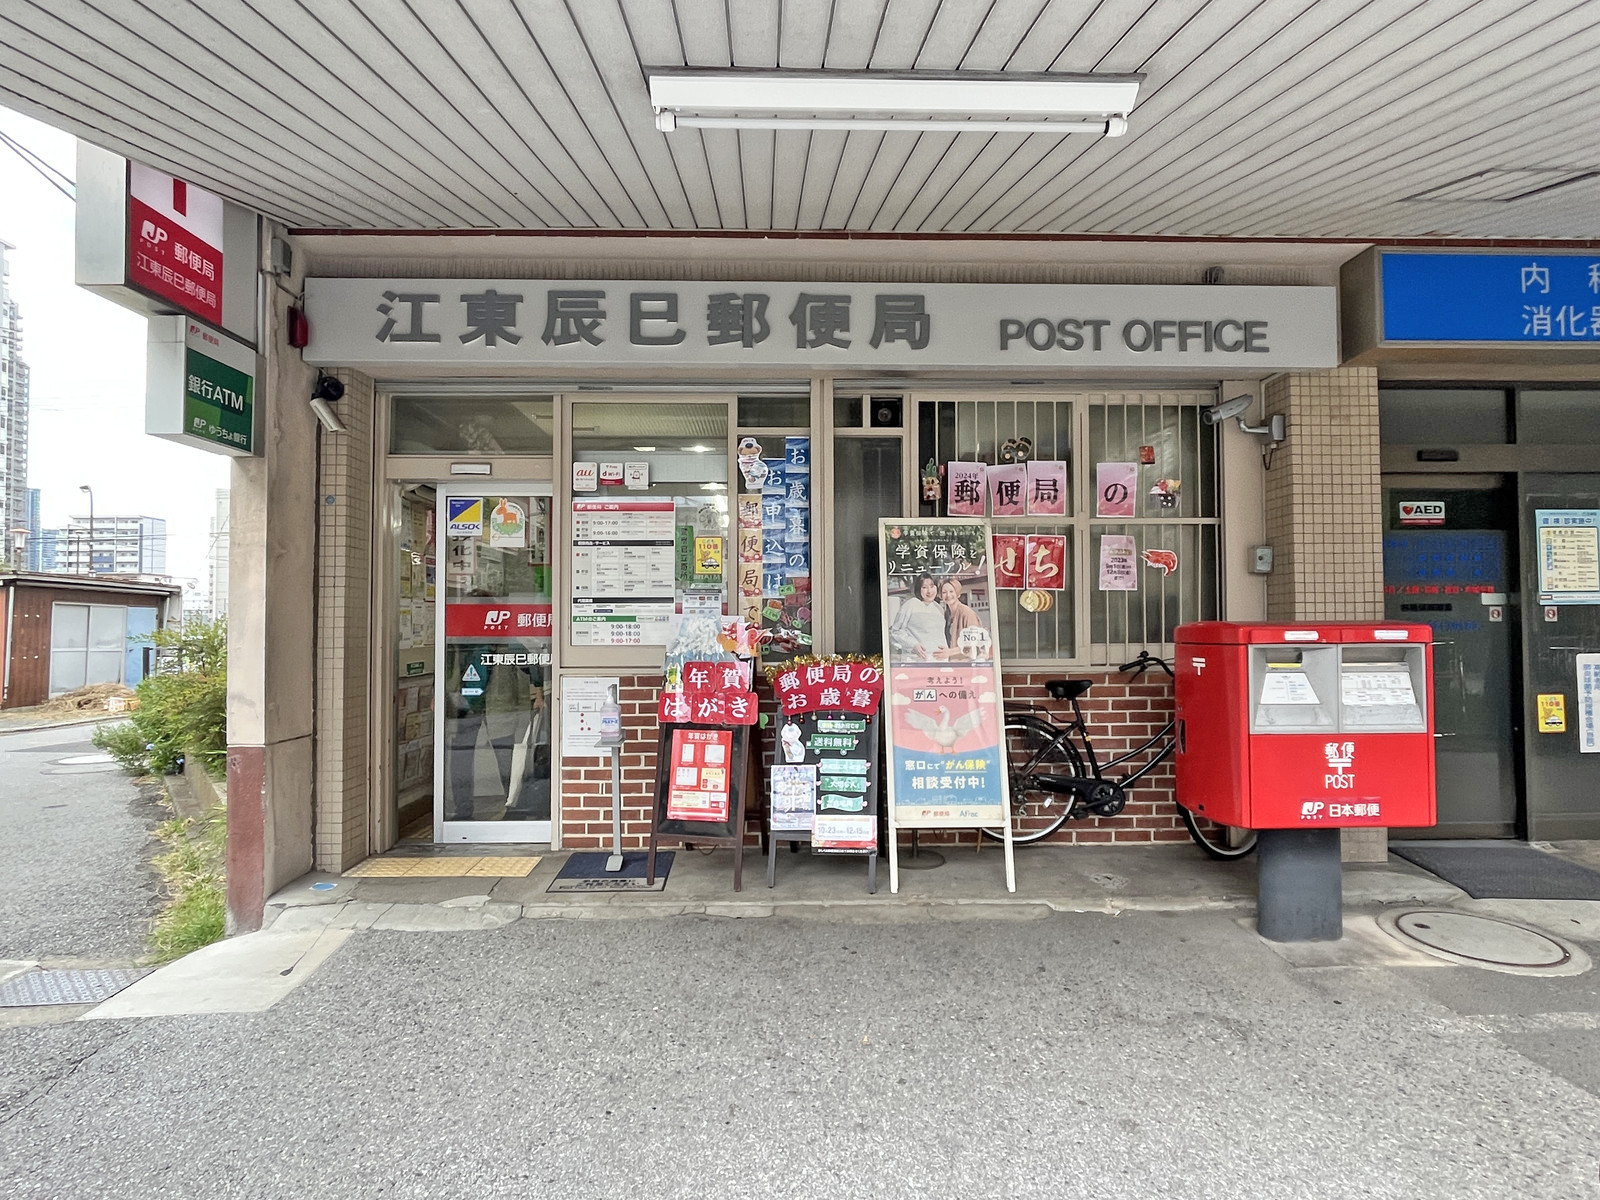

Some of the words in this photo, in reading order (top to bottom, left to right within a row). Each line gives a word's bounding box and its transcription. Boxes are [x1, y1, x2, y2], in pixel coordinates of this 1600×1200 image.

[174, 241, 215, 281] 郵便局
[136, 251, 217, 309] 江東辰巳郵便局
[375, 289, 931, 350] 江東辰巳郵便局
[1000, 318, 1111, 352] POST
[1122, 319, 1270, 353] OFFICE
[187, 374, 244, 412] 銀行ATM
[208, 424, 248, 447] ゆうちょ銀行
[576, 469, 594, 477] au
[1414, 505, 1442, 514] AED
[450, 523, 480, 531] ALSOK
[895, 544, 978, 560] 学資保険を
[480, 653, 552, 665] 江東辰巳郵便
[688, 667, 742, 690] 年賀
[779, 664, 880, 693] 郵便局の
[664, 697, 750, 718] はがき
[787, 687, 874, 710] お歳暮
[814, 737, 853, 747] 送料無料
[1325, 742, 1355, 759] 郵便
[1325, 774, 1355, 789] POST
[1329, 803, 1380, 817] 日本郵便
